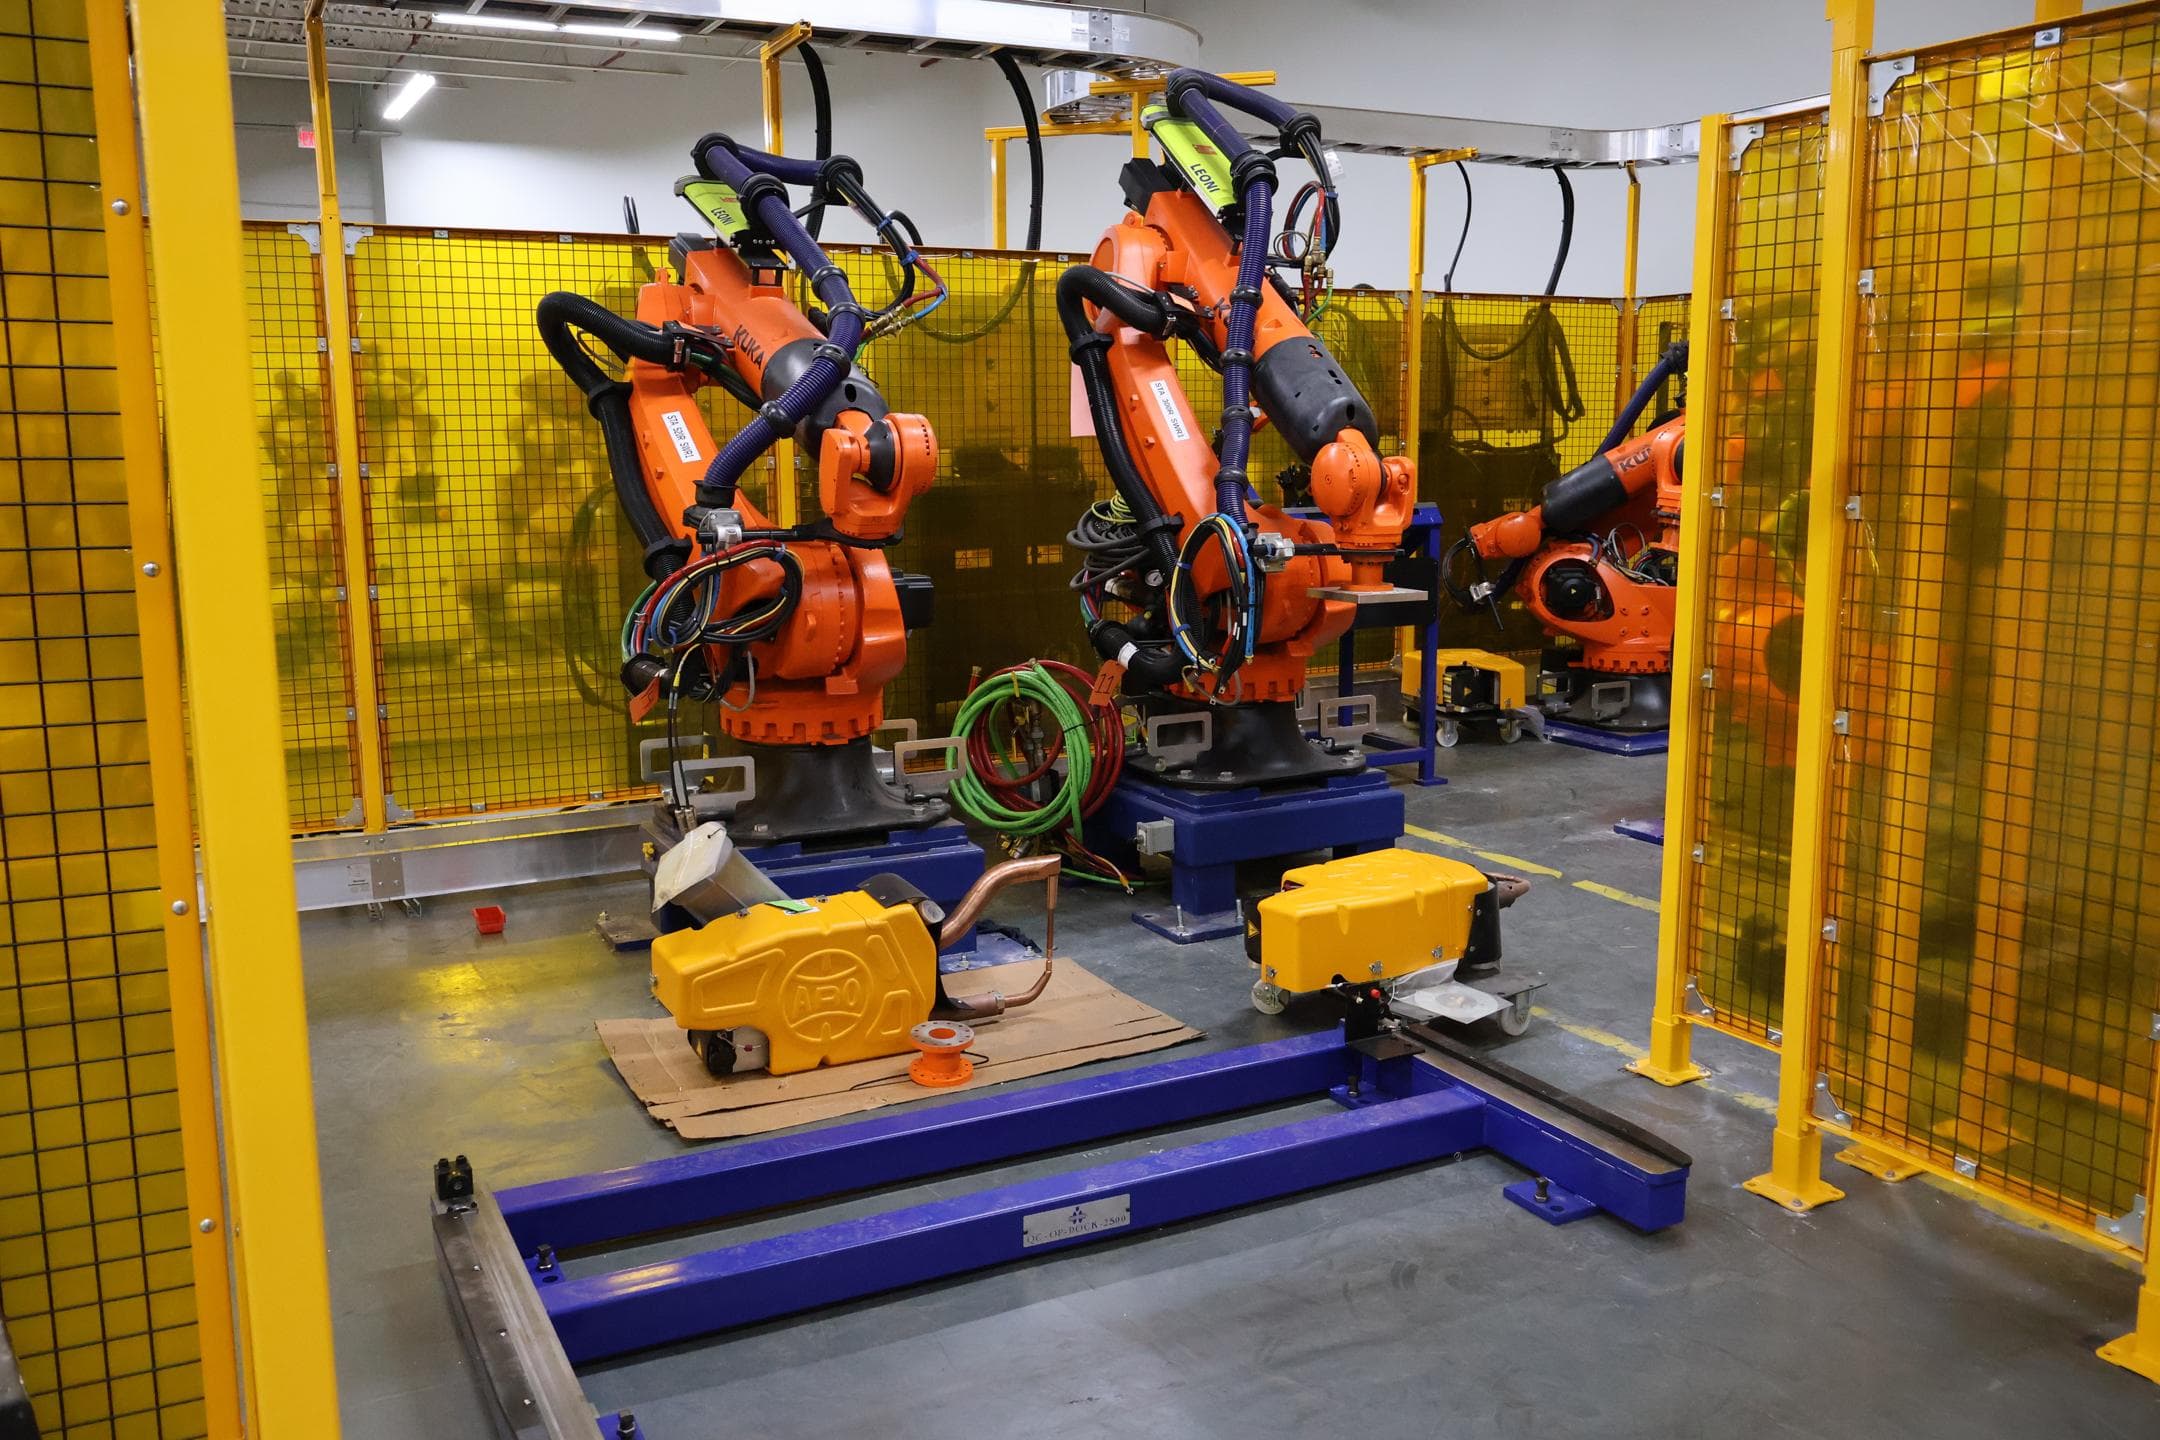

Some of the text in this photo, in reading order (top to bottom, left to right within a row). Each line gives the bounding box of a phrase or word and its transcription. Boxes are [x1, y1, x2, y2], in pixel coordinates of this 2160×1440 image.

[1190, 163, 1221, 193] LEONI
[711, 206, 736, 226] LEONI
[733, 324, 764, 370] KUKA
[1154, 382, 1166, 396] STA
[1170, 417, 1185, 439] SWR1
[667, 414, 679, 426] STA
[679, 441, 695, 459] SWR1
[1619, 446, 1652, 473] KU
[1093, 673, 1115, 695] 11
[791, 977, 861, 1018] ARO
